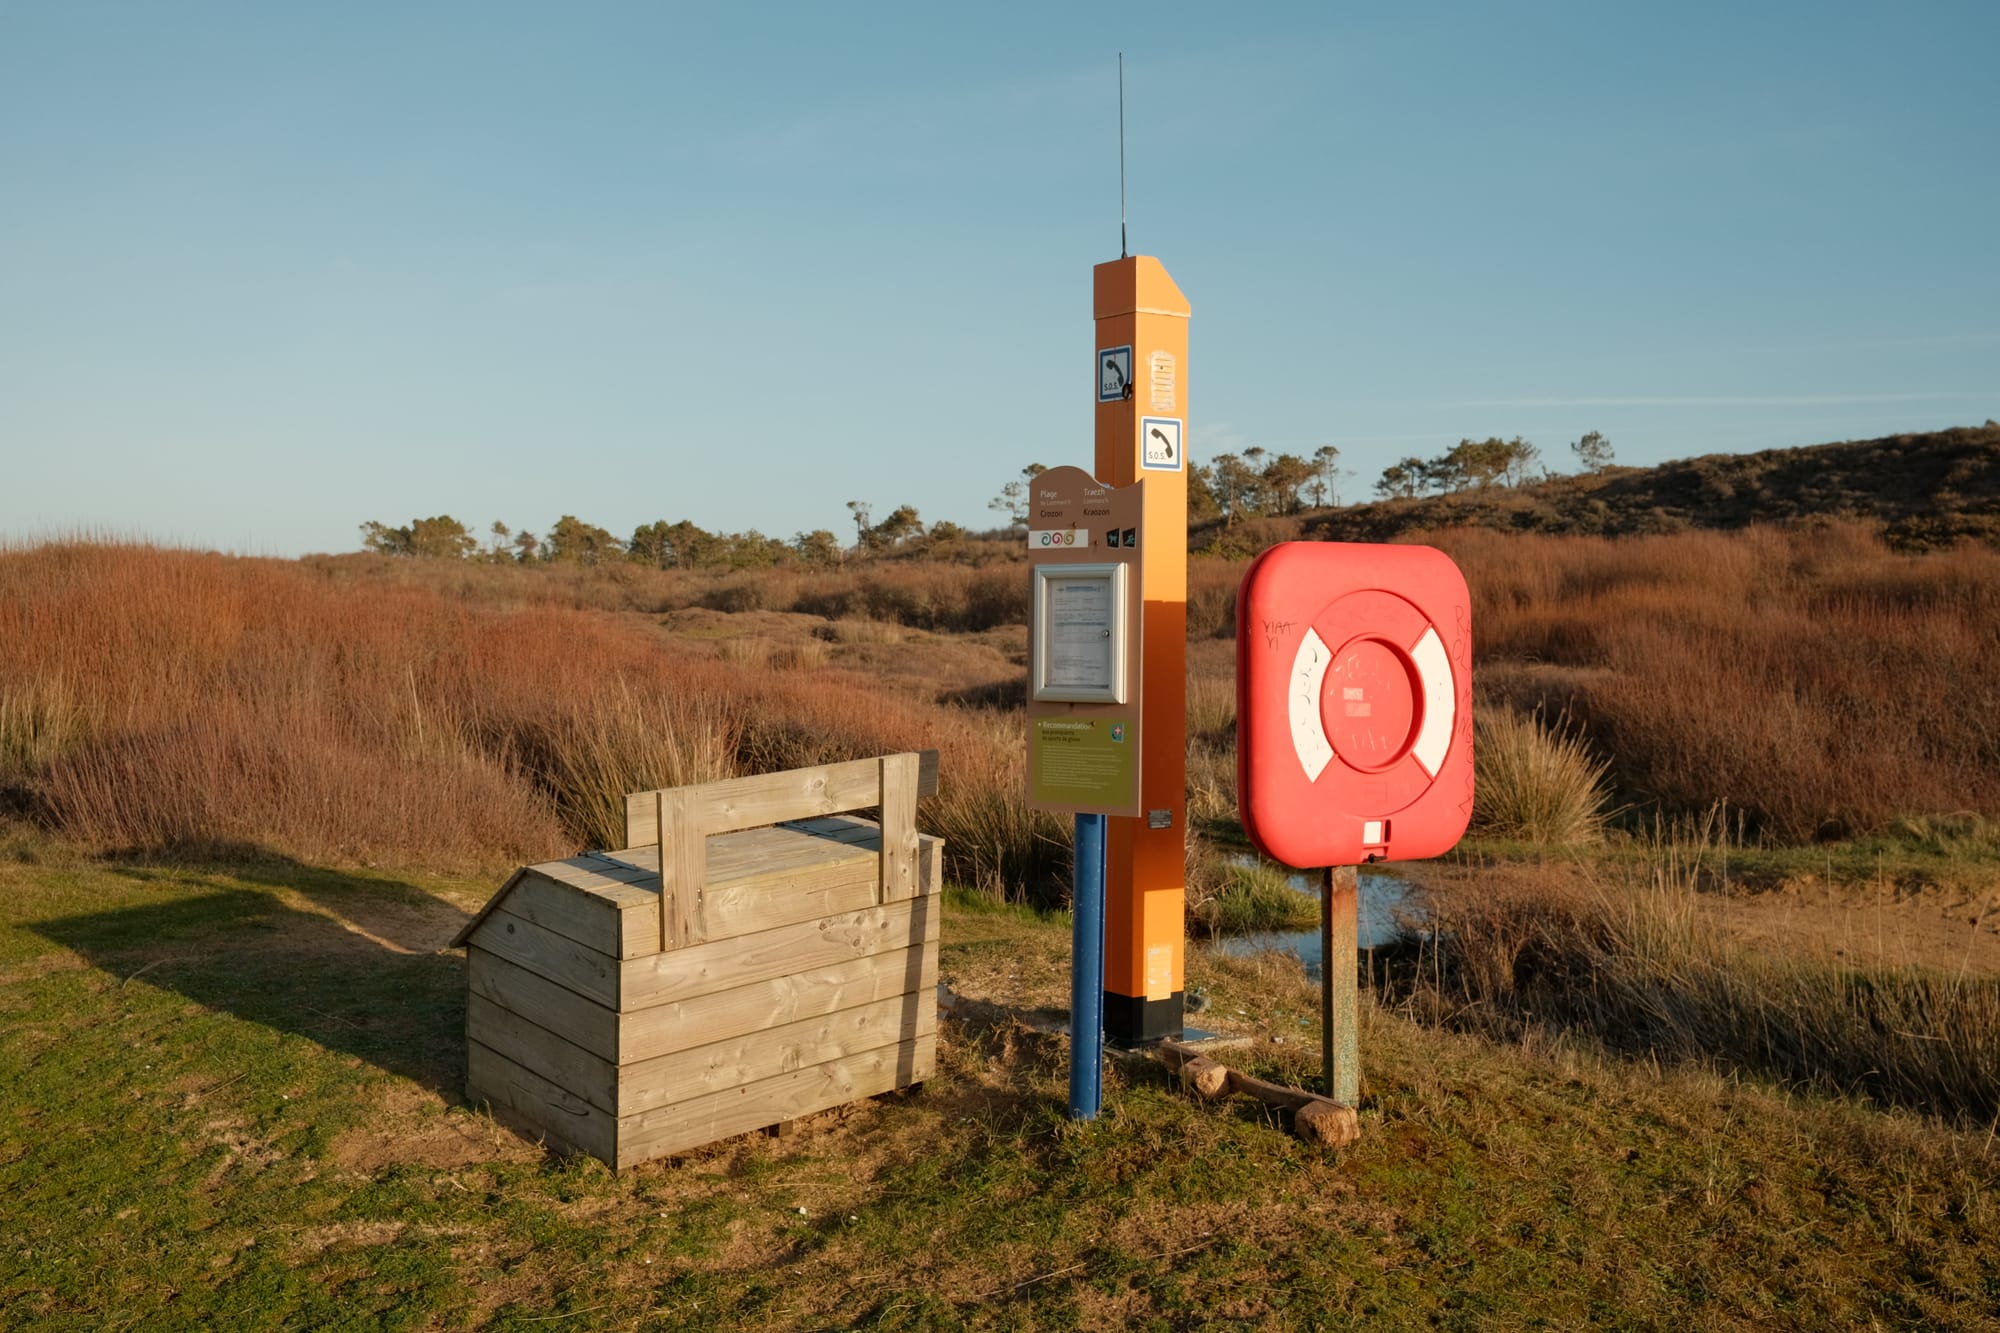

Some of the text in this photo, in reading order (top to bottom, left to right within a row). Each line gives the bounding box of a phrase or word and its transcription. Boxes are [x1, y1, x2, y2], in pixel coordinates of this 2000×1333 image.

[1040, 490, 1057, 500] Plage
[1040, 510, 1063, 518] Crozon
[1083, 509, 1110, 517] Kraozon
[1043, 721, 1093, 730] Recommandation
